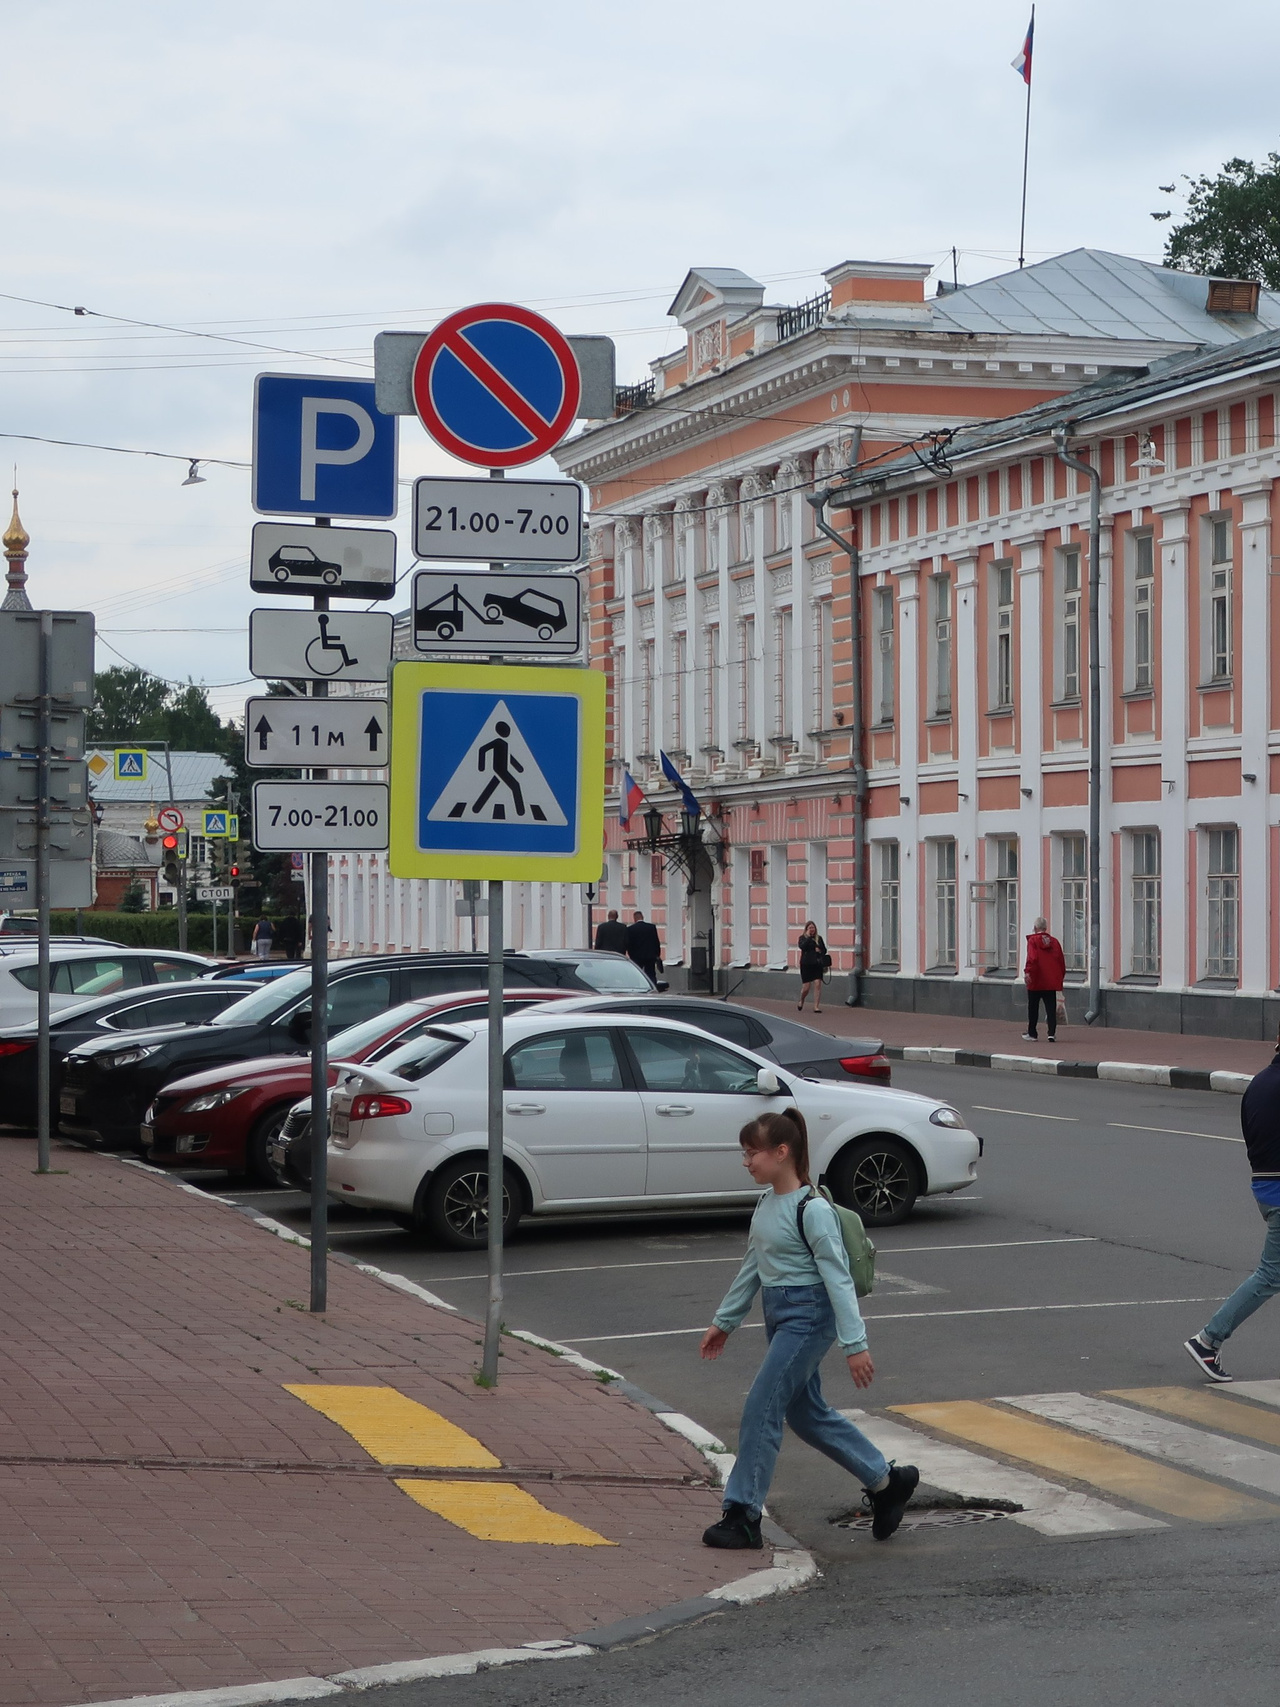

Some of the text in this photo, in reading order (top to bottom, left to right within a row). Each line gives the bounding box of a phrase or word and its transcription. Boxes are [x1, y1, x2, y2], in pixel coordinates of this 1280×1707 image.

[300, 397, 375, 501] P
[425, 506, 569, 535] 21.00-7.00
[268, 805, 379, 827] 7.00-21.00
[201, 889, 230, 898] СТОП
